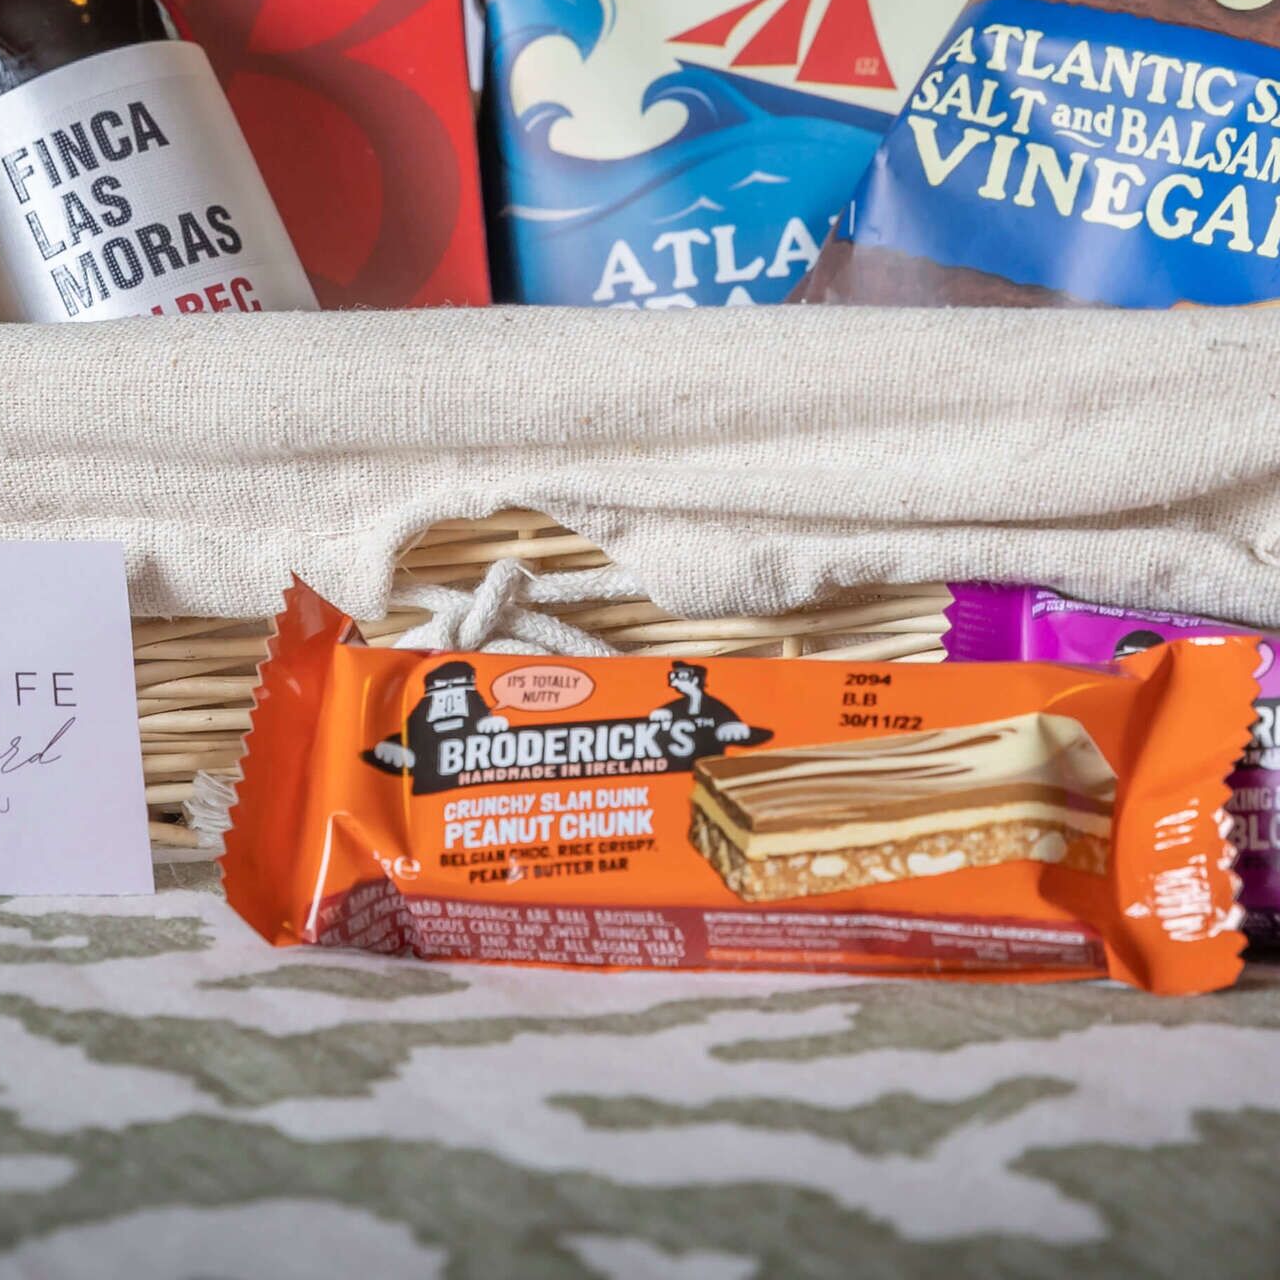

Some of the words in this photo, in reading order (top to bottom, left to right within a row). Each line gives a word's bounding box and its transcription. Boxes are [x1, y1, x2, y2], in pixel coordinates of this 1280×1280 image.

[936, 23, 1237, 116] ATLANTIC
[911, 70, 1047, 135] SALT
[1050, 104, 1113, 138] and
[1, 99, 171, 205] FINCA
[24, 174, 133, 262] LAS
[49, 203, 243, 318] MORAS
[507, 677, 527, 688] IT'S
[532, 676, 581, 689] TOTALLY
[522, 691, 562, 704] NUTTY
[844, 673, 892, 687] 2094
[838, 713, 924, 731] 30/11/22
[438, 721, 696, 777] BRODERICK'S
[457, 763, 556, 786] HANDMADE
[560, 762, 581, 776] IN
[591, 757, 668, 775] IRELAND
[443, 793, 536, 822] CRUNCHY
[540, 790, 592, 813] SLAM
[595, 786, 650, 809] DUNK
[444, 814, 555, 850] PEANUT
[559, 809, 654, 841] CHUNK
[439, 849, 505, 867] BELGIAN
[558, 842, 594, 858] RICE
[534, 859, 594, 878] BUTTER
[598, 857, 629, 871] BAR
